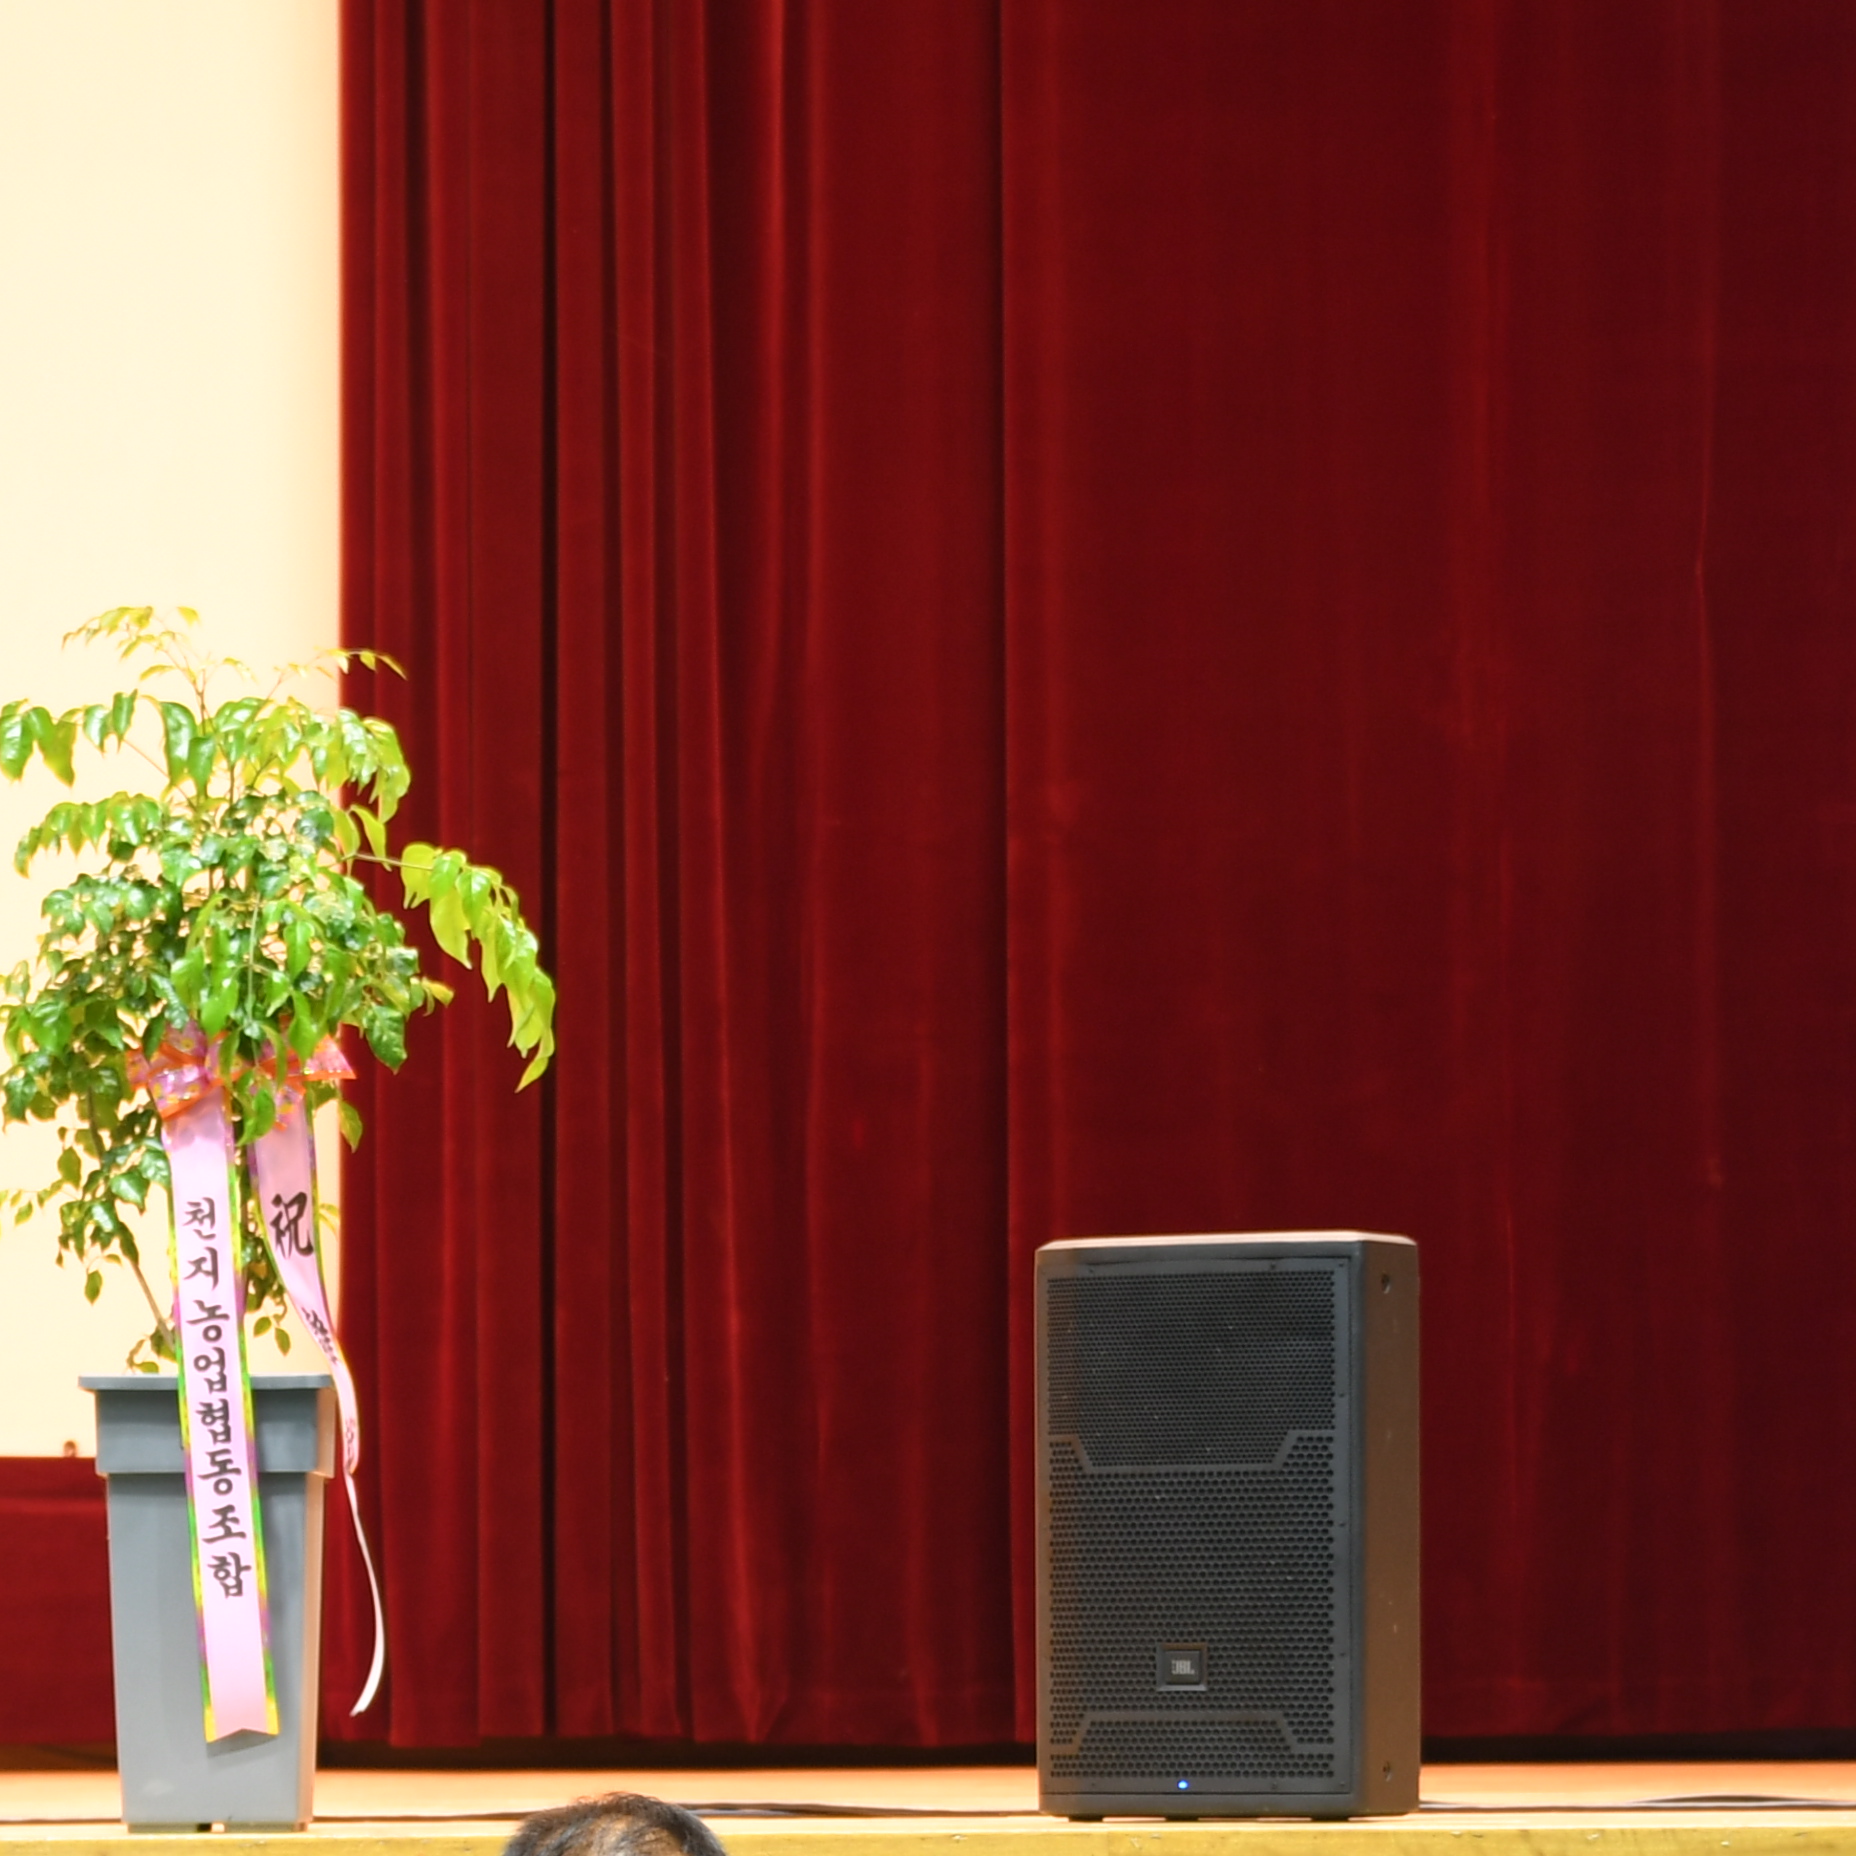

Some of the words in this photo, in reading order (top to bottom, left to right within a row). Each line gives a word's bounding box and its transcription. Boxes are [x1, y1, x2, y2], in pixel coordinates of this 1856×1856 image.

[269, 1192, 315, 1260] 祝
[183, 1196, 253, 1600] 천지농업협동조합
[1171, 1660, 1195, 1675] JBL
